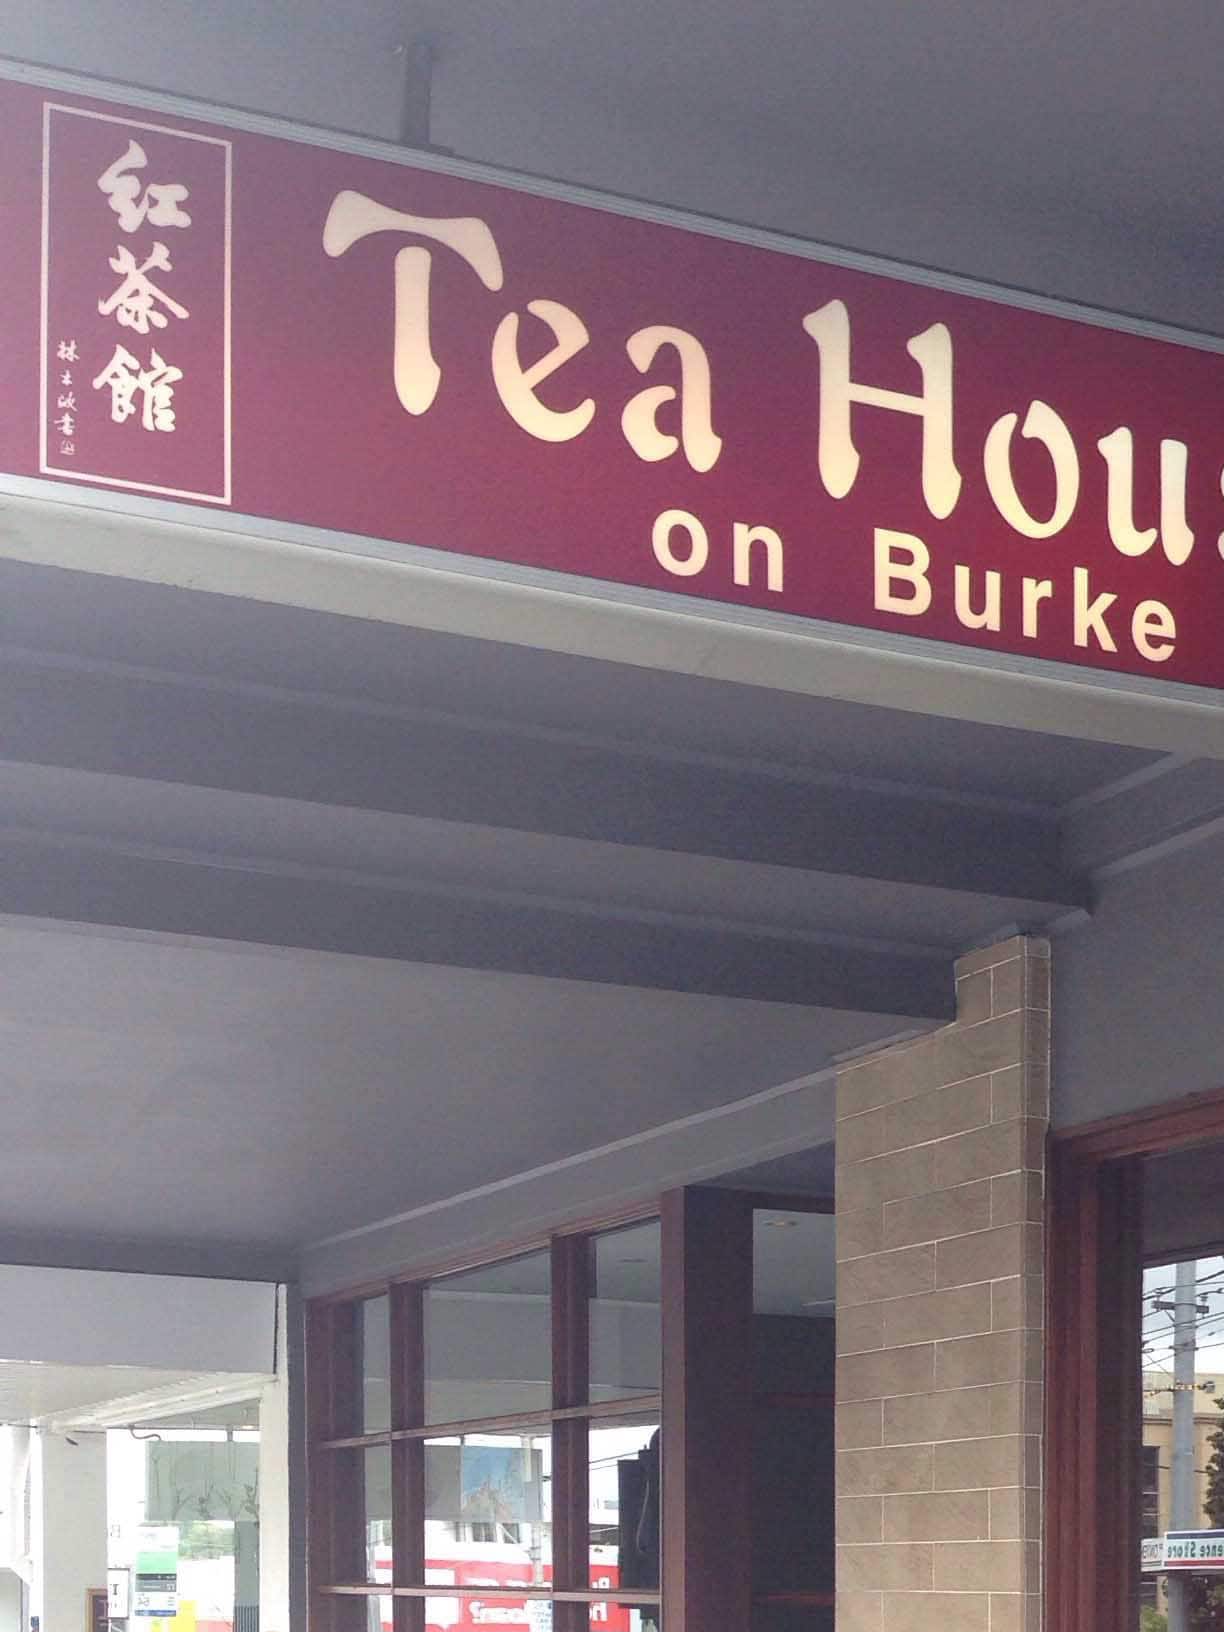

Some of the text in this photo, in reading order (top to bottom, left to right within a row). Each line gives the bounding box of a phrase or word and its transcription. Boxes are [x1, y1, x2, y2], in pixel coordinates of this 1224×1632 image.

[322, 189, 723, 474] Tea
[651, 508, 1178, 663] on Burke
